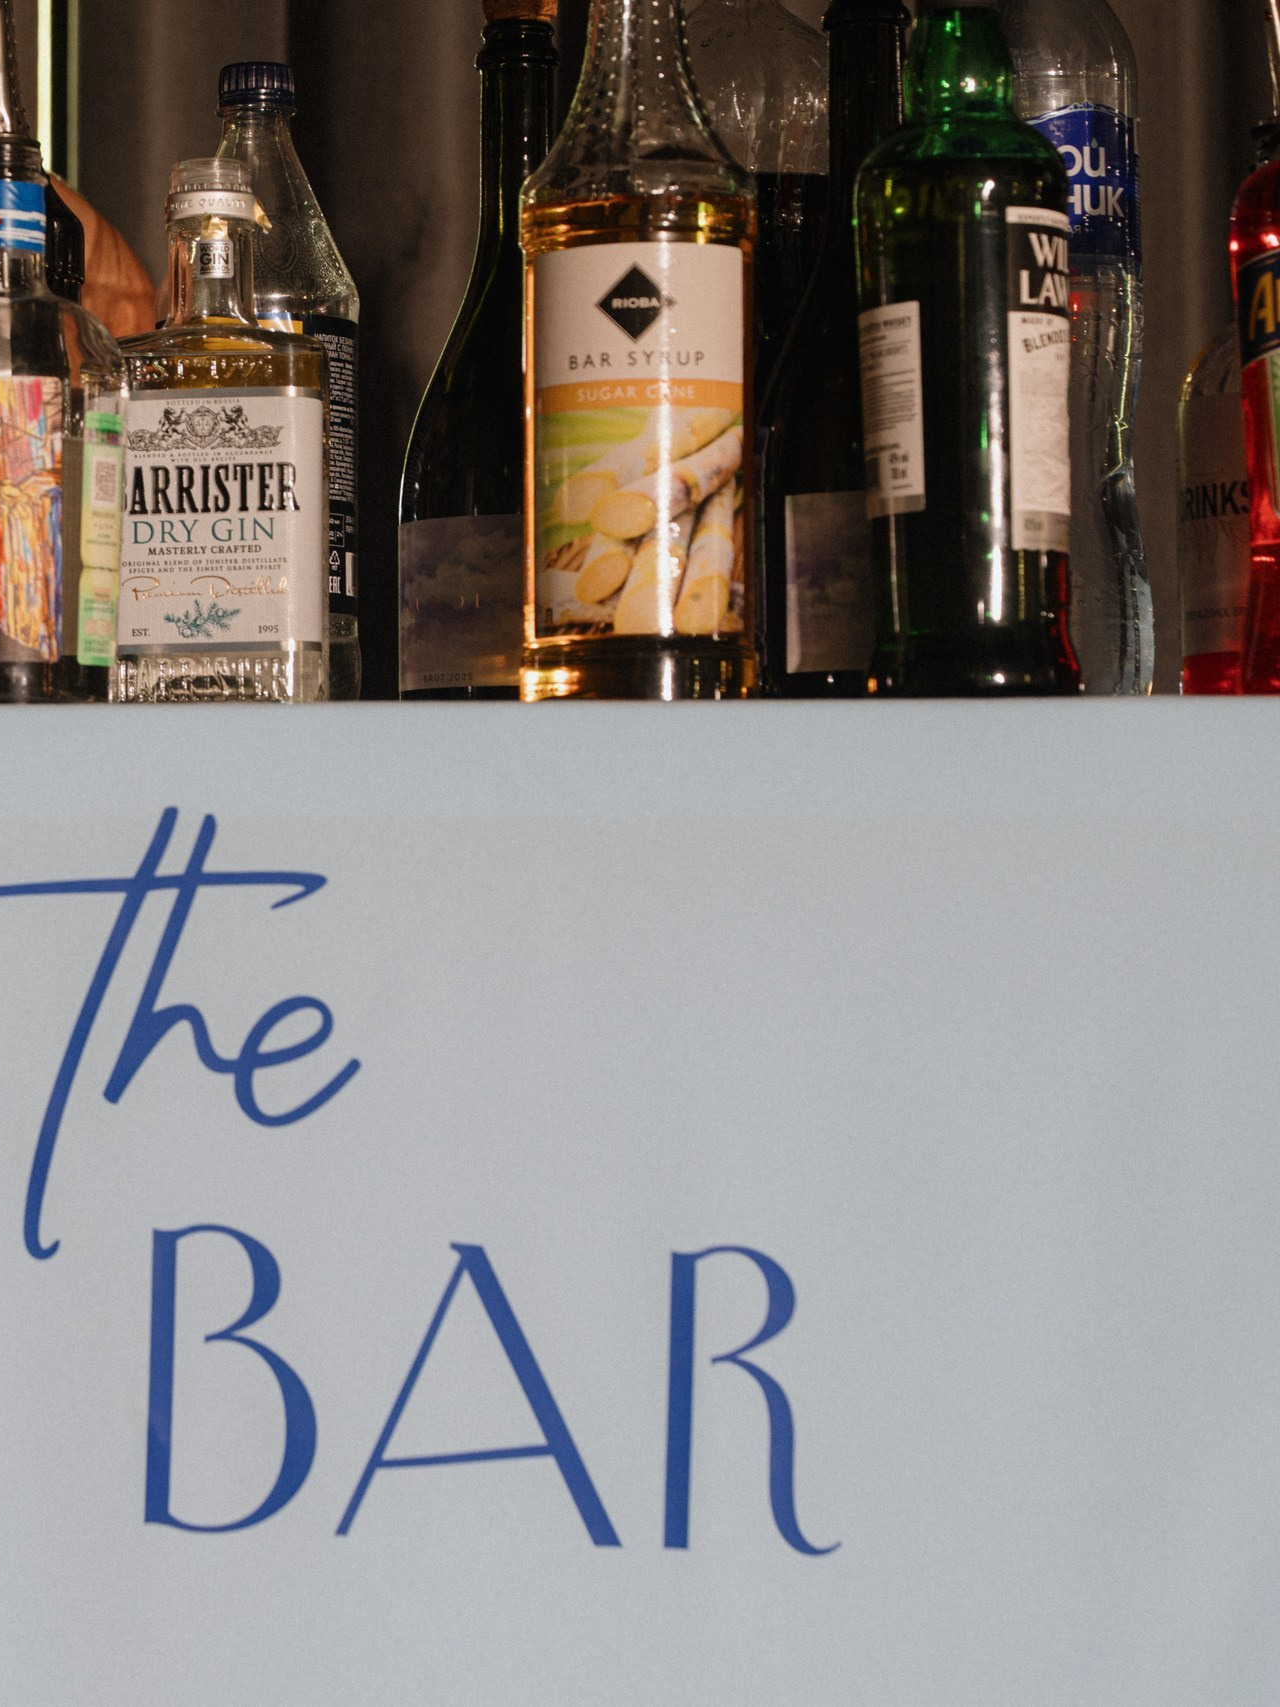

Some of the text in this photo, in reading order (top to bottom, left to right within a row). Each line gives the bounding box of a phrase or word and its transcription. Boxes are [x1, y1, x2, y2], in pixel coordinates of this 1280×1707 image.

[199, 198, 247, 209] QUALITY
[200, 253, 229, 266] GIN
[611, 297, 660, 310] RIOBA
[569, 350, 705, 370] BAR SYRUP
[577, 384, 695, 402] SUGAR CANE
[122, 462, 300, 515] ARRISTER
[1180, 480, 1249, 523] RINKS
[132, 517, 275, 545] DRY GIN
[147, 544, 262, 556] MASTERLY CRAFTED
[206, 558, 238, 566] JUNIPER
[242, 557, 287, 565] DISTILLATE
[131, 625, 279, 638] EST. 1995
[423, 674, 445, 683] BRUT
[143, 1224, 842, 1556] BAR
